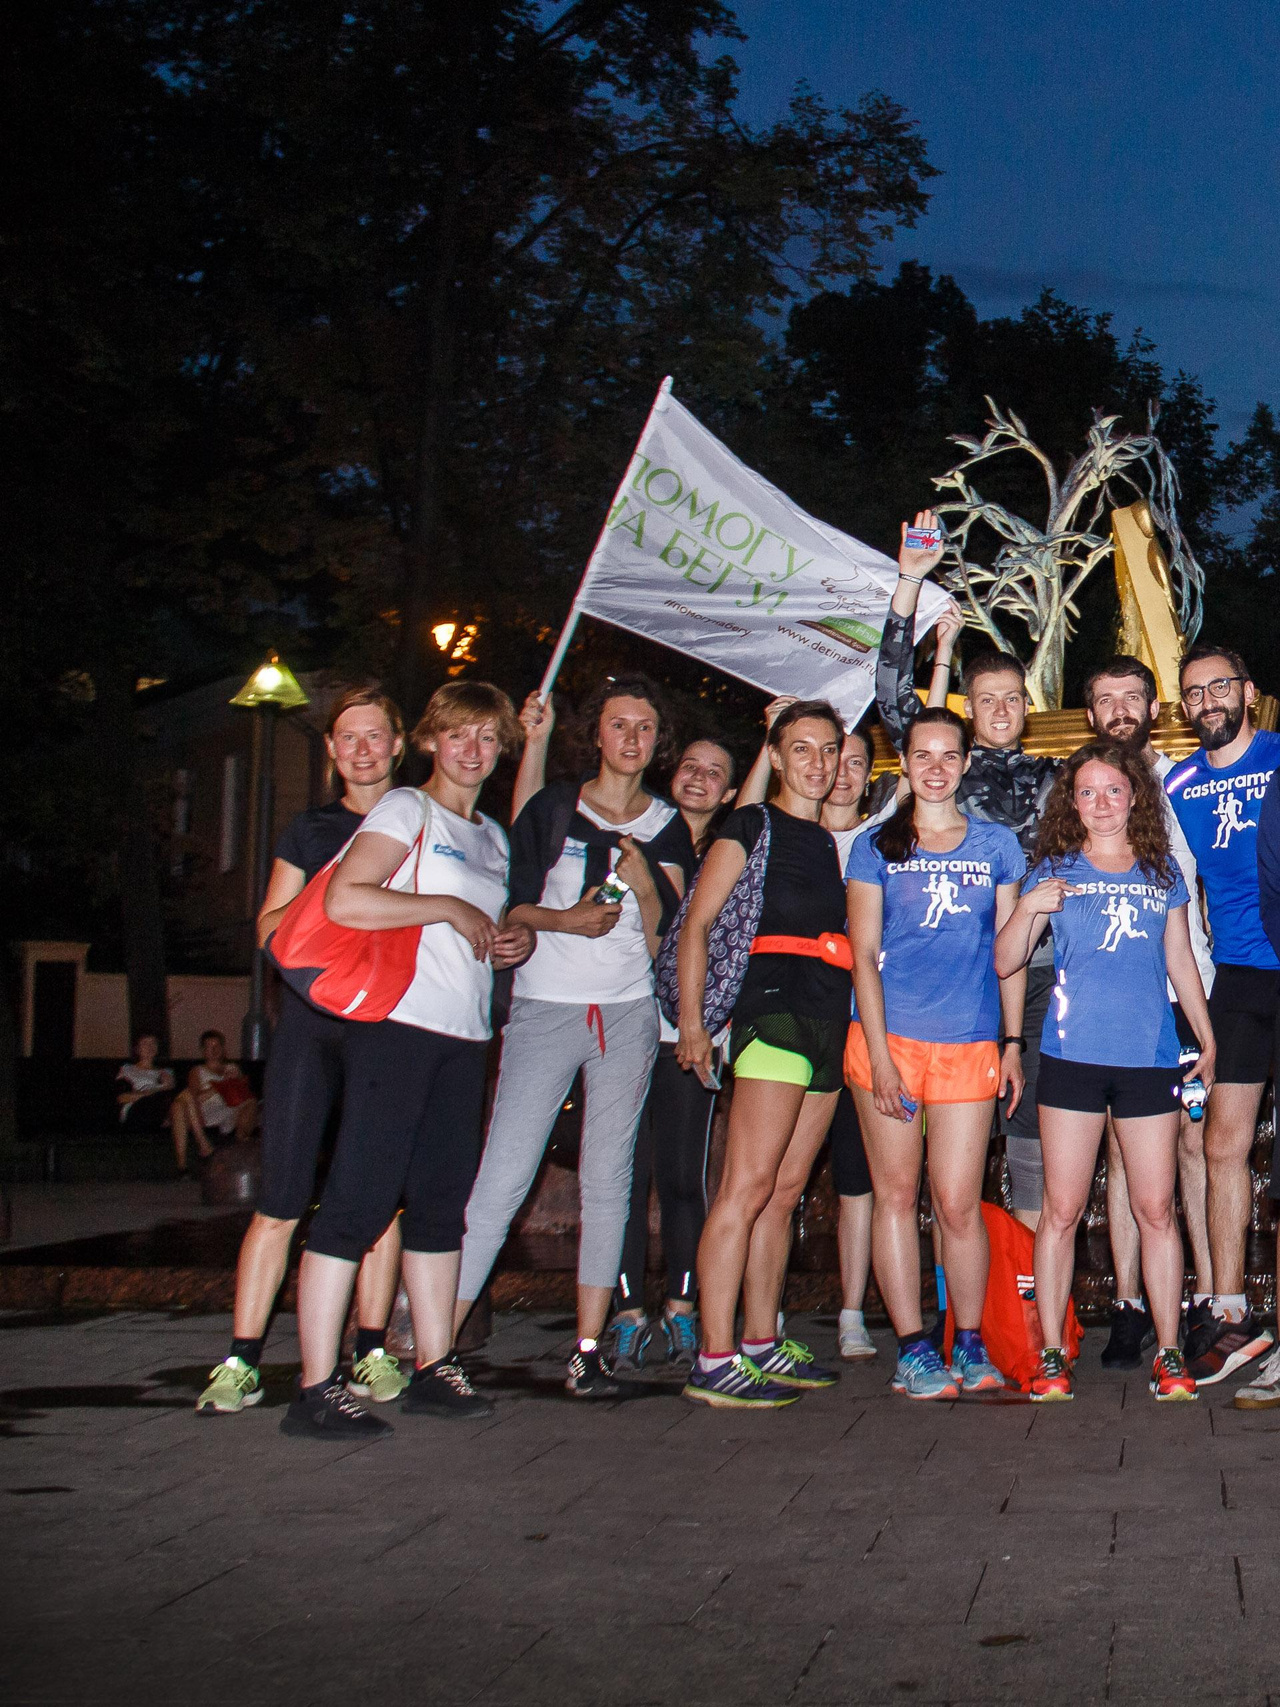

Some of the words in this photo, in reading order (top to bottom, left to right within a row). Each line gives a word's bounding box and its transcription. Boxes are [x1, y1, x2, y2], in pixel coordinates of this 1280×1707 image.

[658, 529, 789, 616] БЕГУ!
[777, 625, 878, 677] www.detinashi.ru
[1246, 785, 1268, 802] ru
[886, 858, 991, 875] castorama
[962, 873, 992, 888] run
[1142, 897, 1166, 915] run
